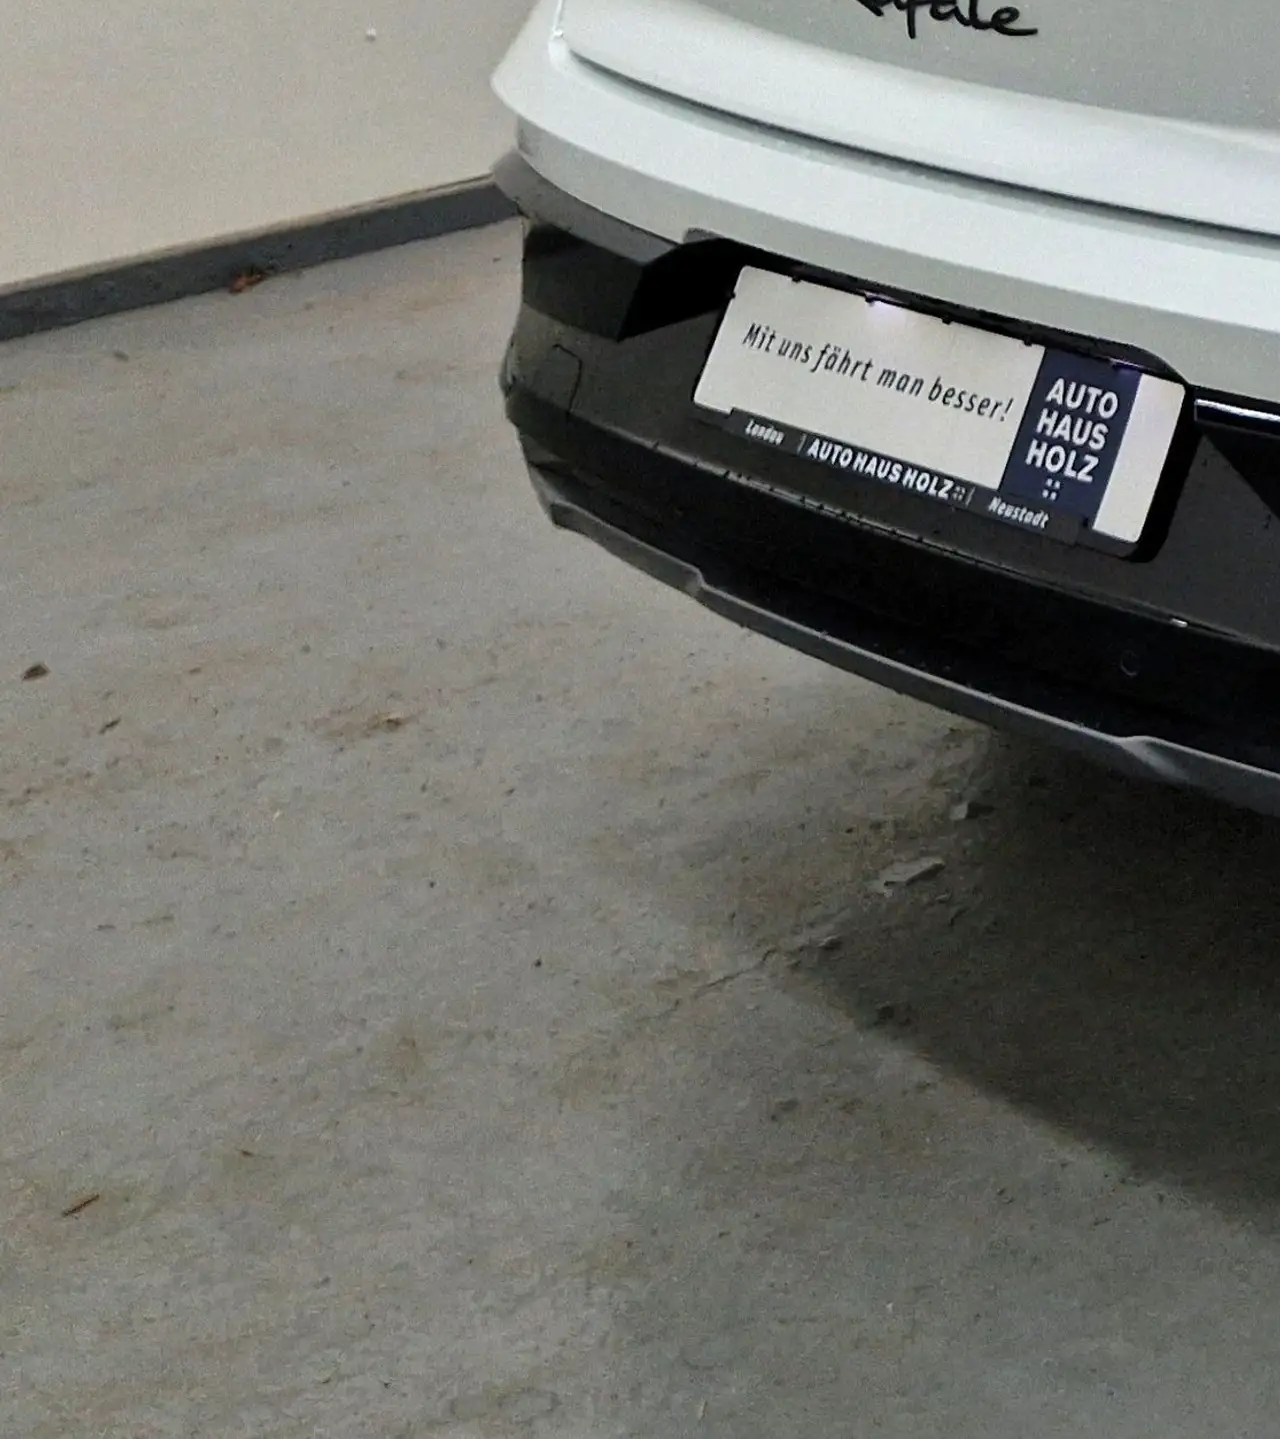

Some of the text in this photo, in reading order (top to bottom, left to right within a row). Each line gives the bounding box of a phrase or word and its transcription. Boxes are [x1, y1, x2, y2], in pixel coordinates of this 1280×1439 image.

[742, 322, 1014, 422] Mit uns fährt man besser!
[1045, 378, 1118, 419] AUTO
[1036, 408, 1109, 450] HAUS
[1025, 439, 1099, 483] HOLZ
[902, 467, 954, 500] HOLZ
[988, 496, 1050, 529] Neustadt
